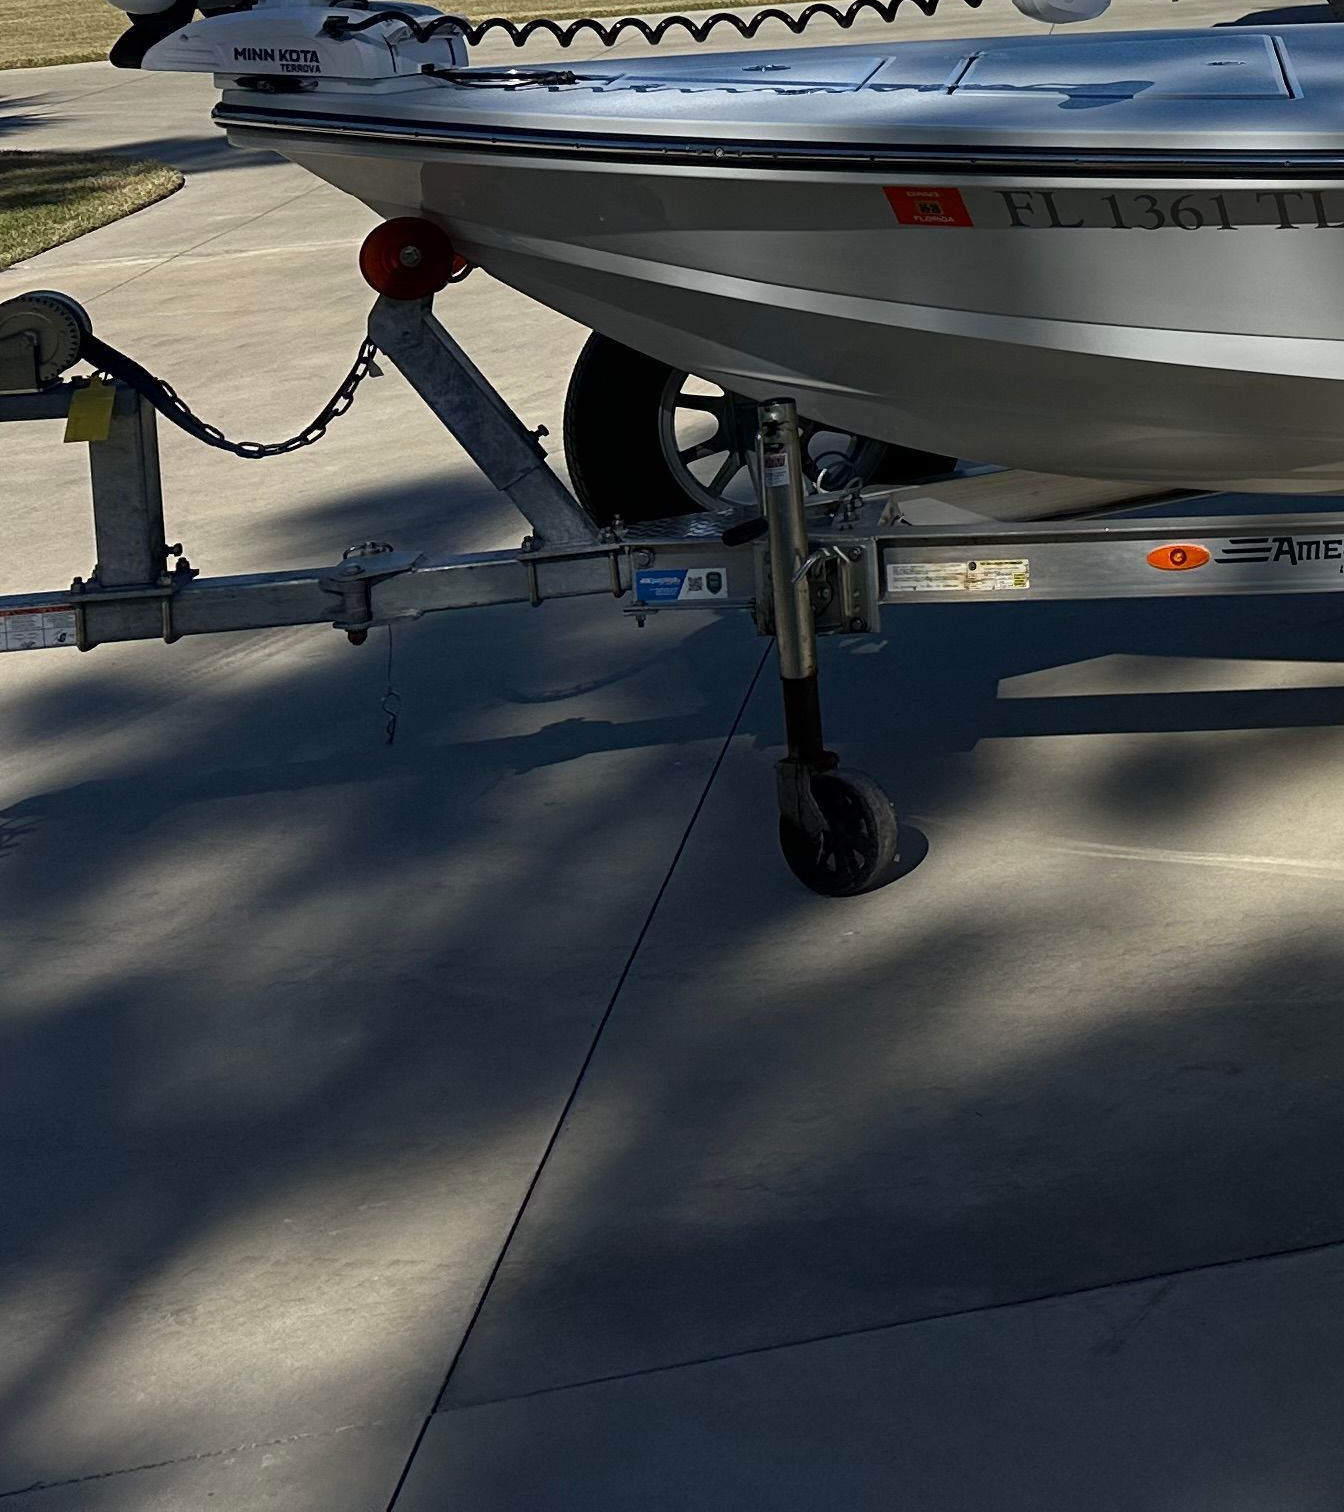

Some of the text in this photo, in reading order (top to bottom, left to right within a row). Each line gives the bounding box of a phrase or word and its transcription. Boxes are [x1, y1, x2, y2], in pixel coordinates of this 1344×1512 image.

[234, 47, 319, 64] MINN KOTA
[280, 63, 322, 74] TERROVA
[995, 189, 1084, 229] FL
[1101, 192, 1239, 232] 1361
